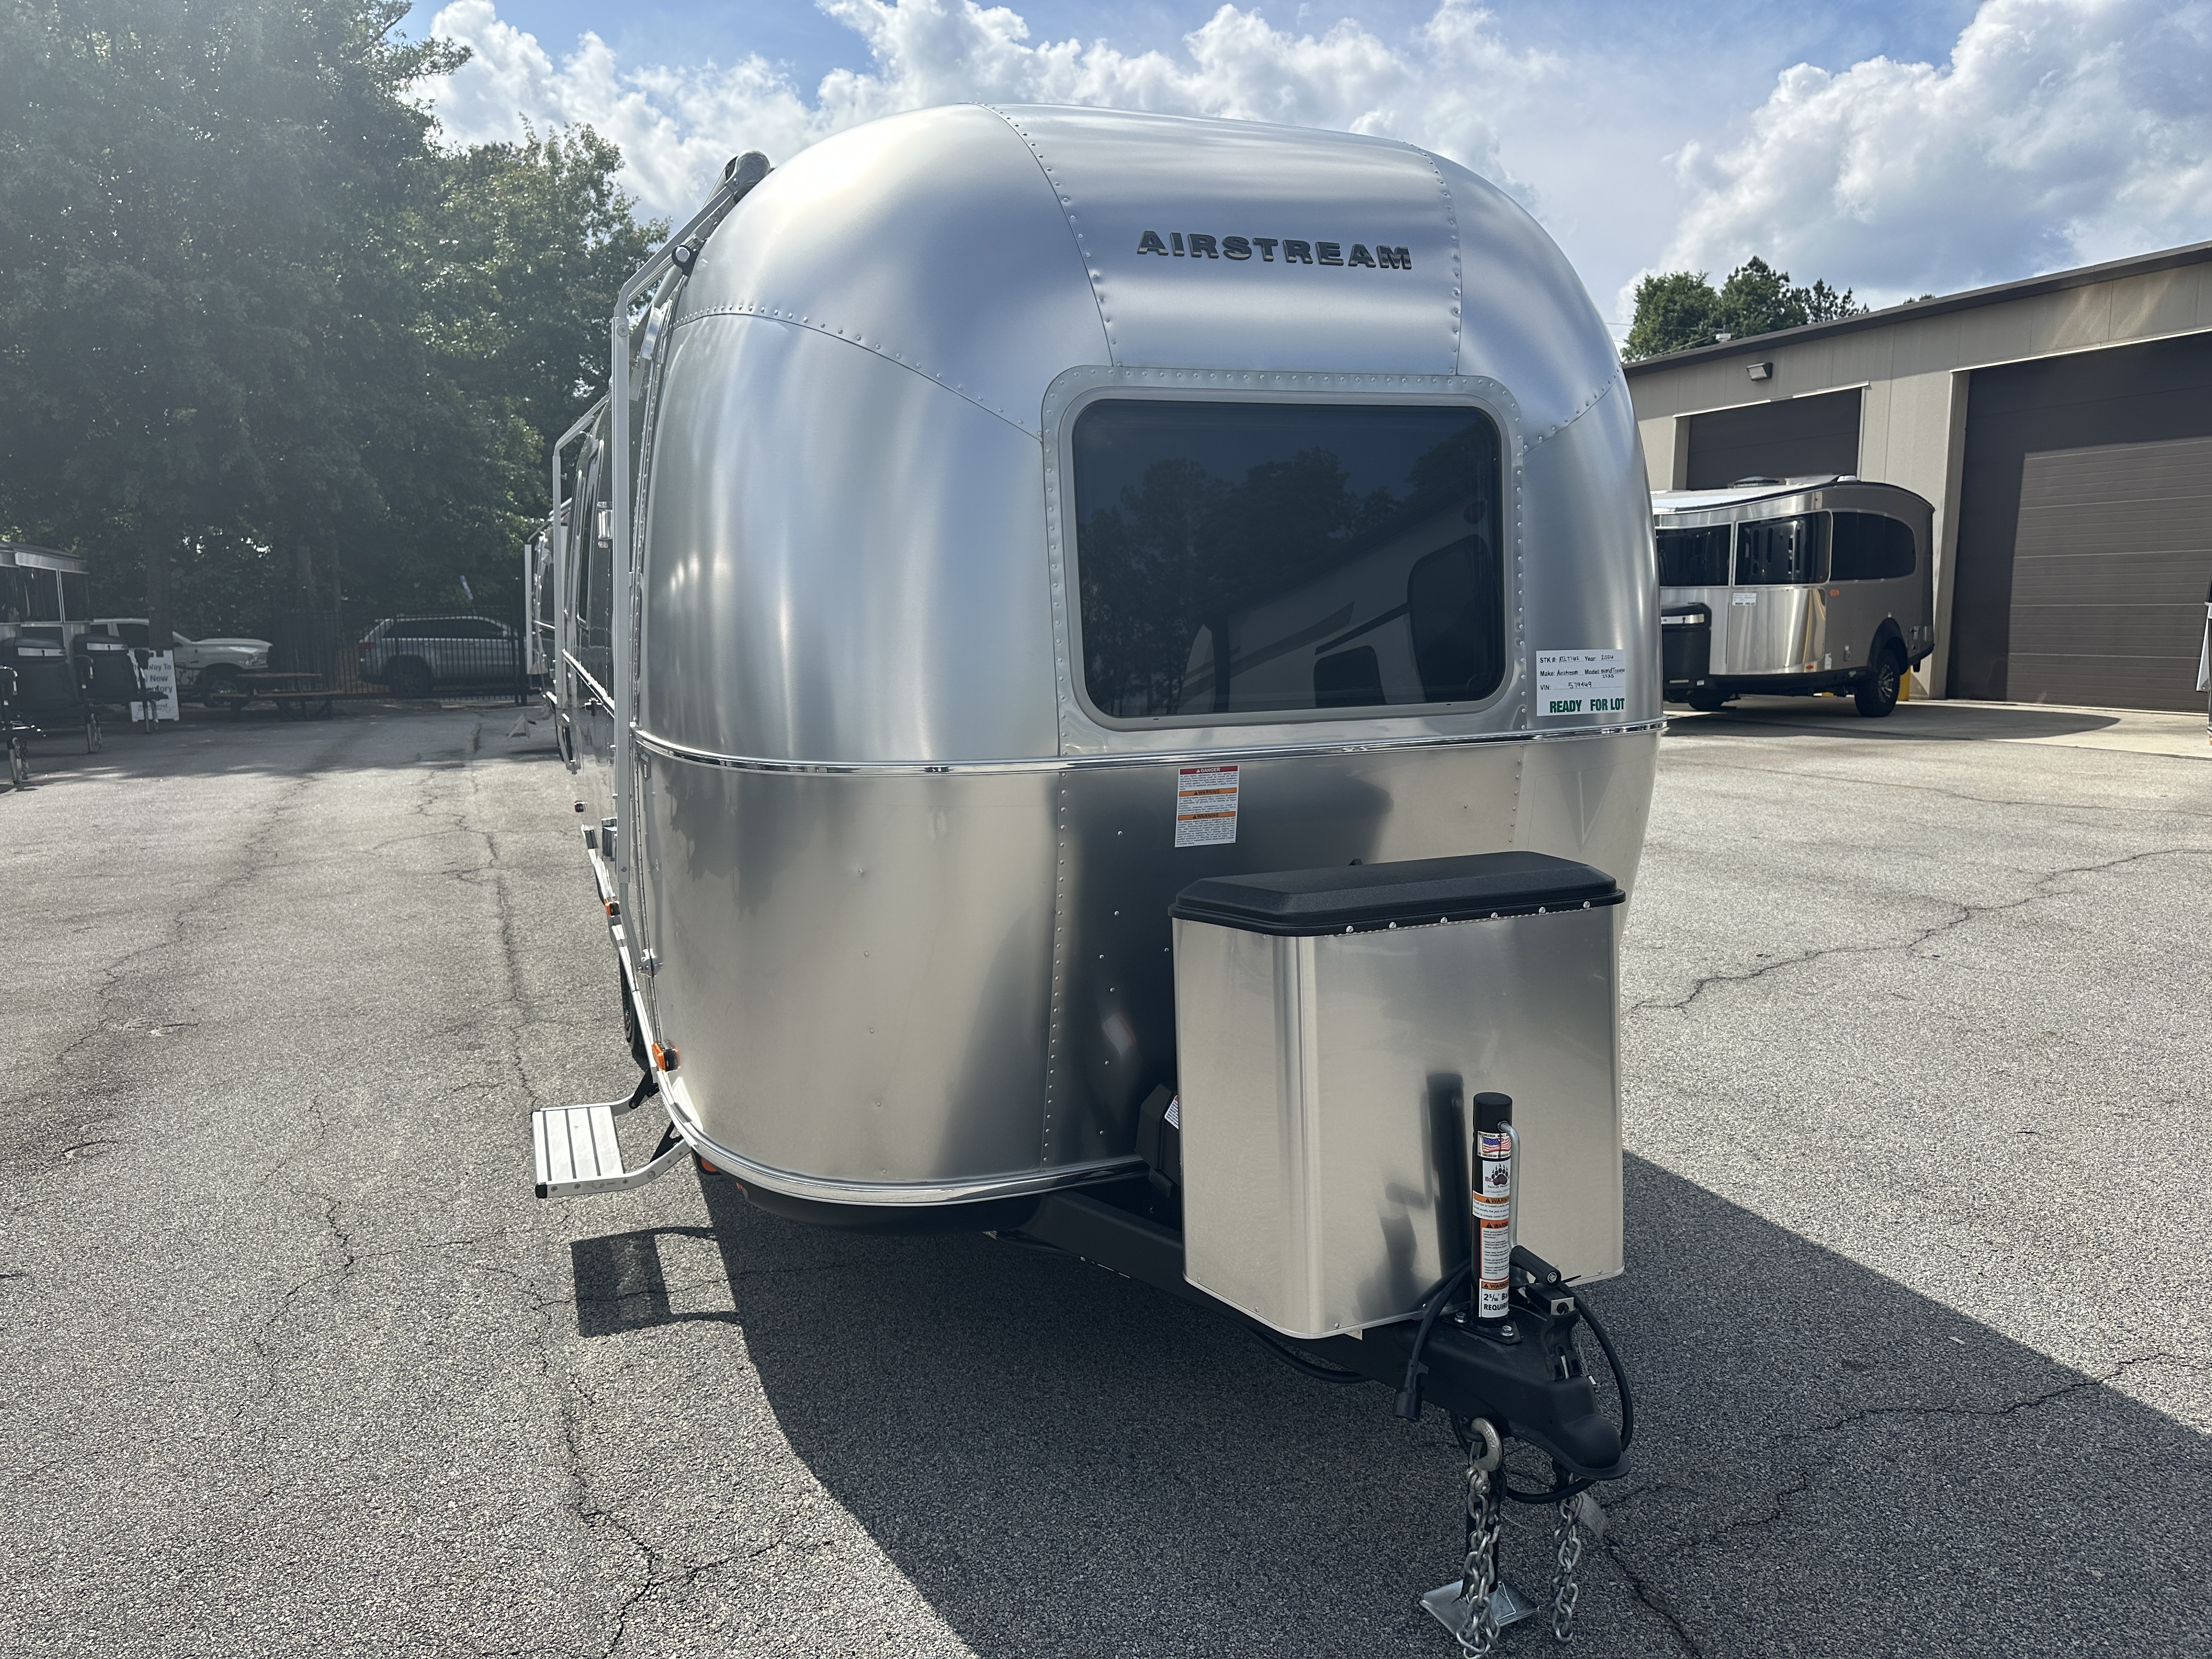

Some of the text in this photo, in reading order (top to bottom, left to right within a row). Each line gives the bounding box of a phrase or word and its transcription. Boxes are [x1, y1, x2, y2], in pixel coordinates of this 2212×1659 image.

[1137, 230, 1412, 269] AIRSTREAM
[1550, 698, 1625, 713] READY FOR LOT
